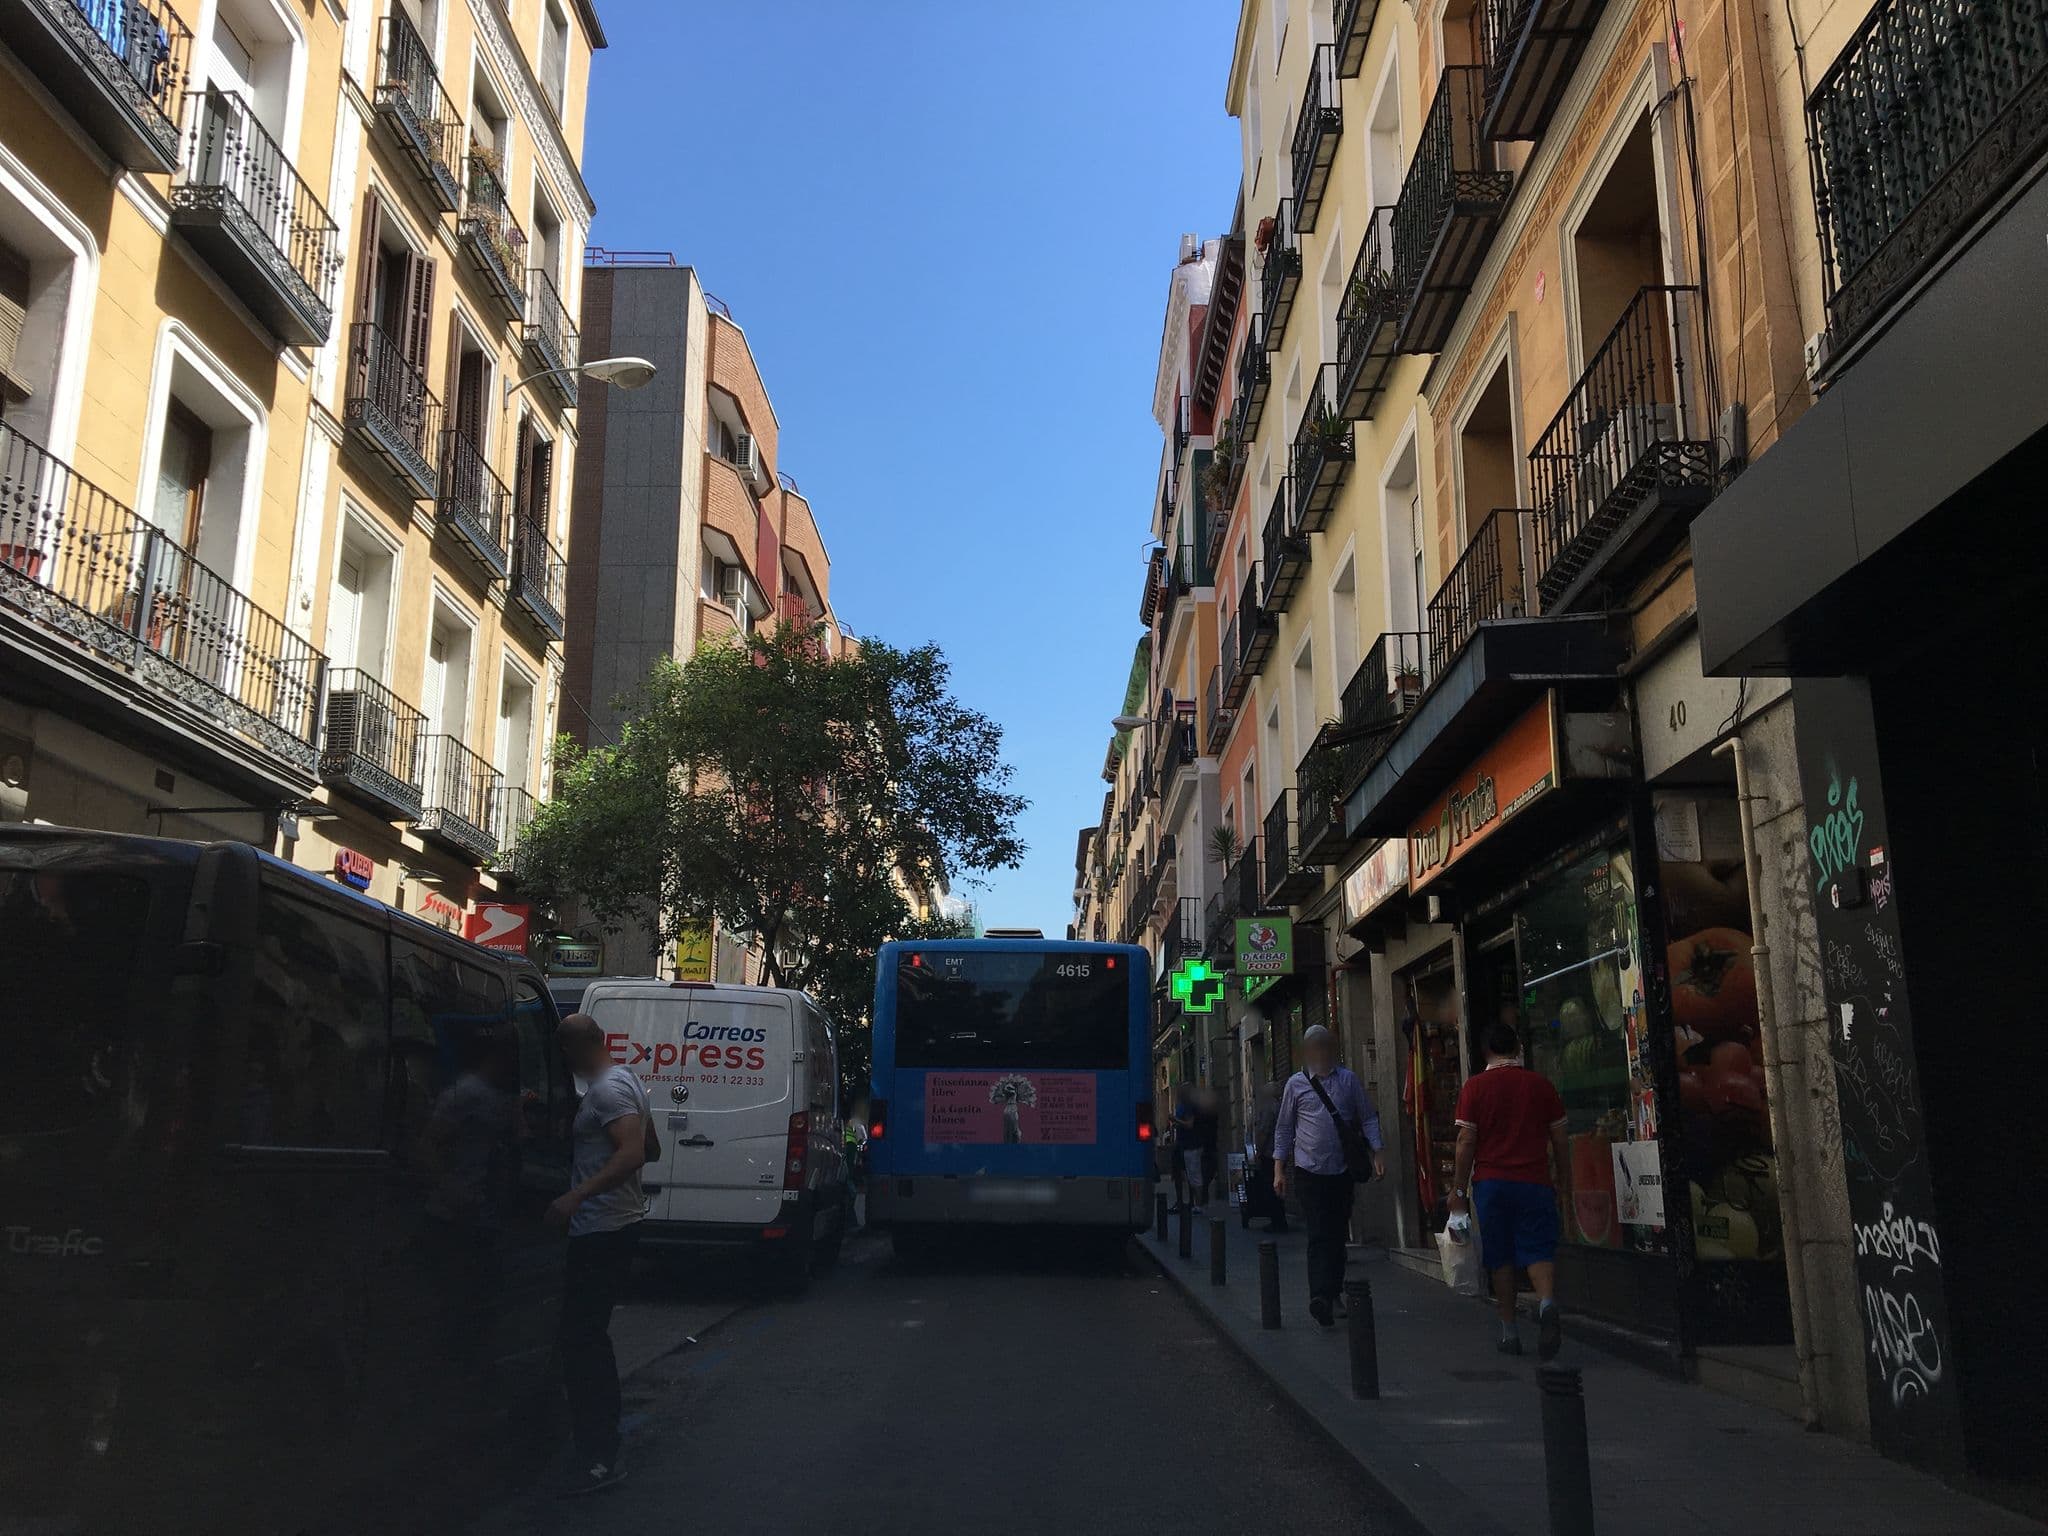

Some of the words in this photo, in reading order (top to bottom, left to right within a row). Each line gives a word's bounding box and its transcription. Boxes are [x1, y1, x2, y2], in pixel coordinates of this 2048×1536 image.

[1669, 700, 1687, 732] 40
[945, 958, 964, 966] EMT
[1056, 964, 1091, 978] 4615
[1247, 962, 1282, 971] FOOD
[684, 1021, 767, 1043] Correos
[606, 1033, 766, 1073] Express
[700, 1075, 719, 1084] 902
[730, 1076, 743, 1085] 22
[745, 1077, 765, 1086] 333
[4, 1223, 105, 1257] Trafic
